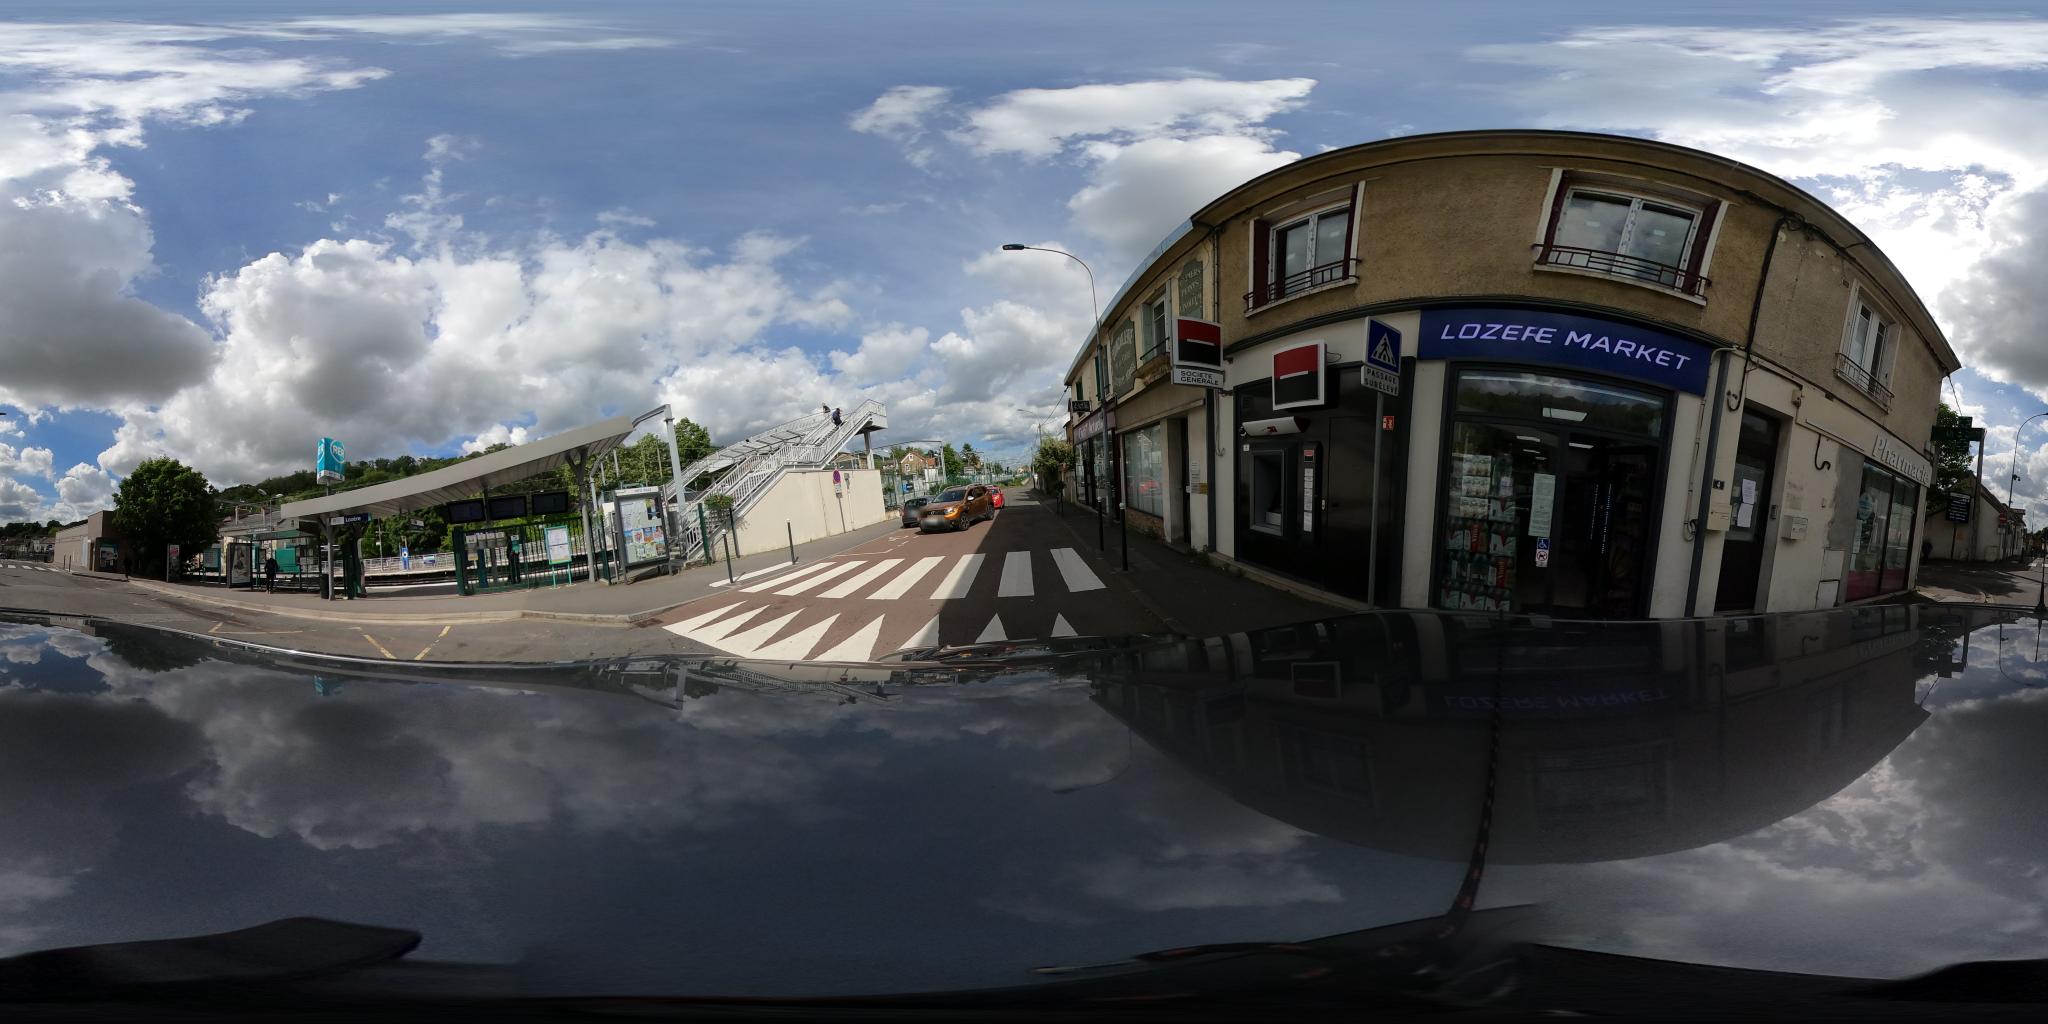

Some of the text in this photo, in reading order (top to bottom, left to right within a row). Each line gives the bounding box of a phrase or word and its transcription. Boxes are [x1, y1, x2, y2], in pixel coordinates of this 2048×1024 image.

[1564, 330, 1691, 370] MARKET
[1366, 368, 1397, 384] PASSAGE
[332, 445, 345, 456] RER
[1872, 434, 1930, 485] Pharmacie
